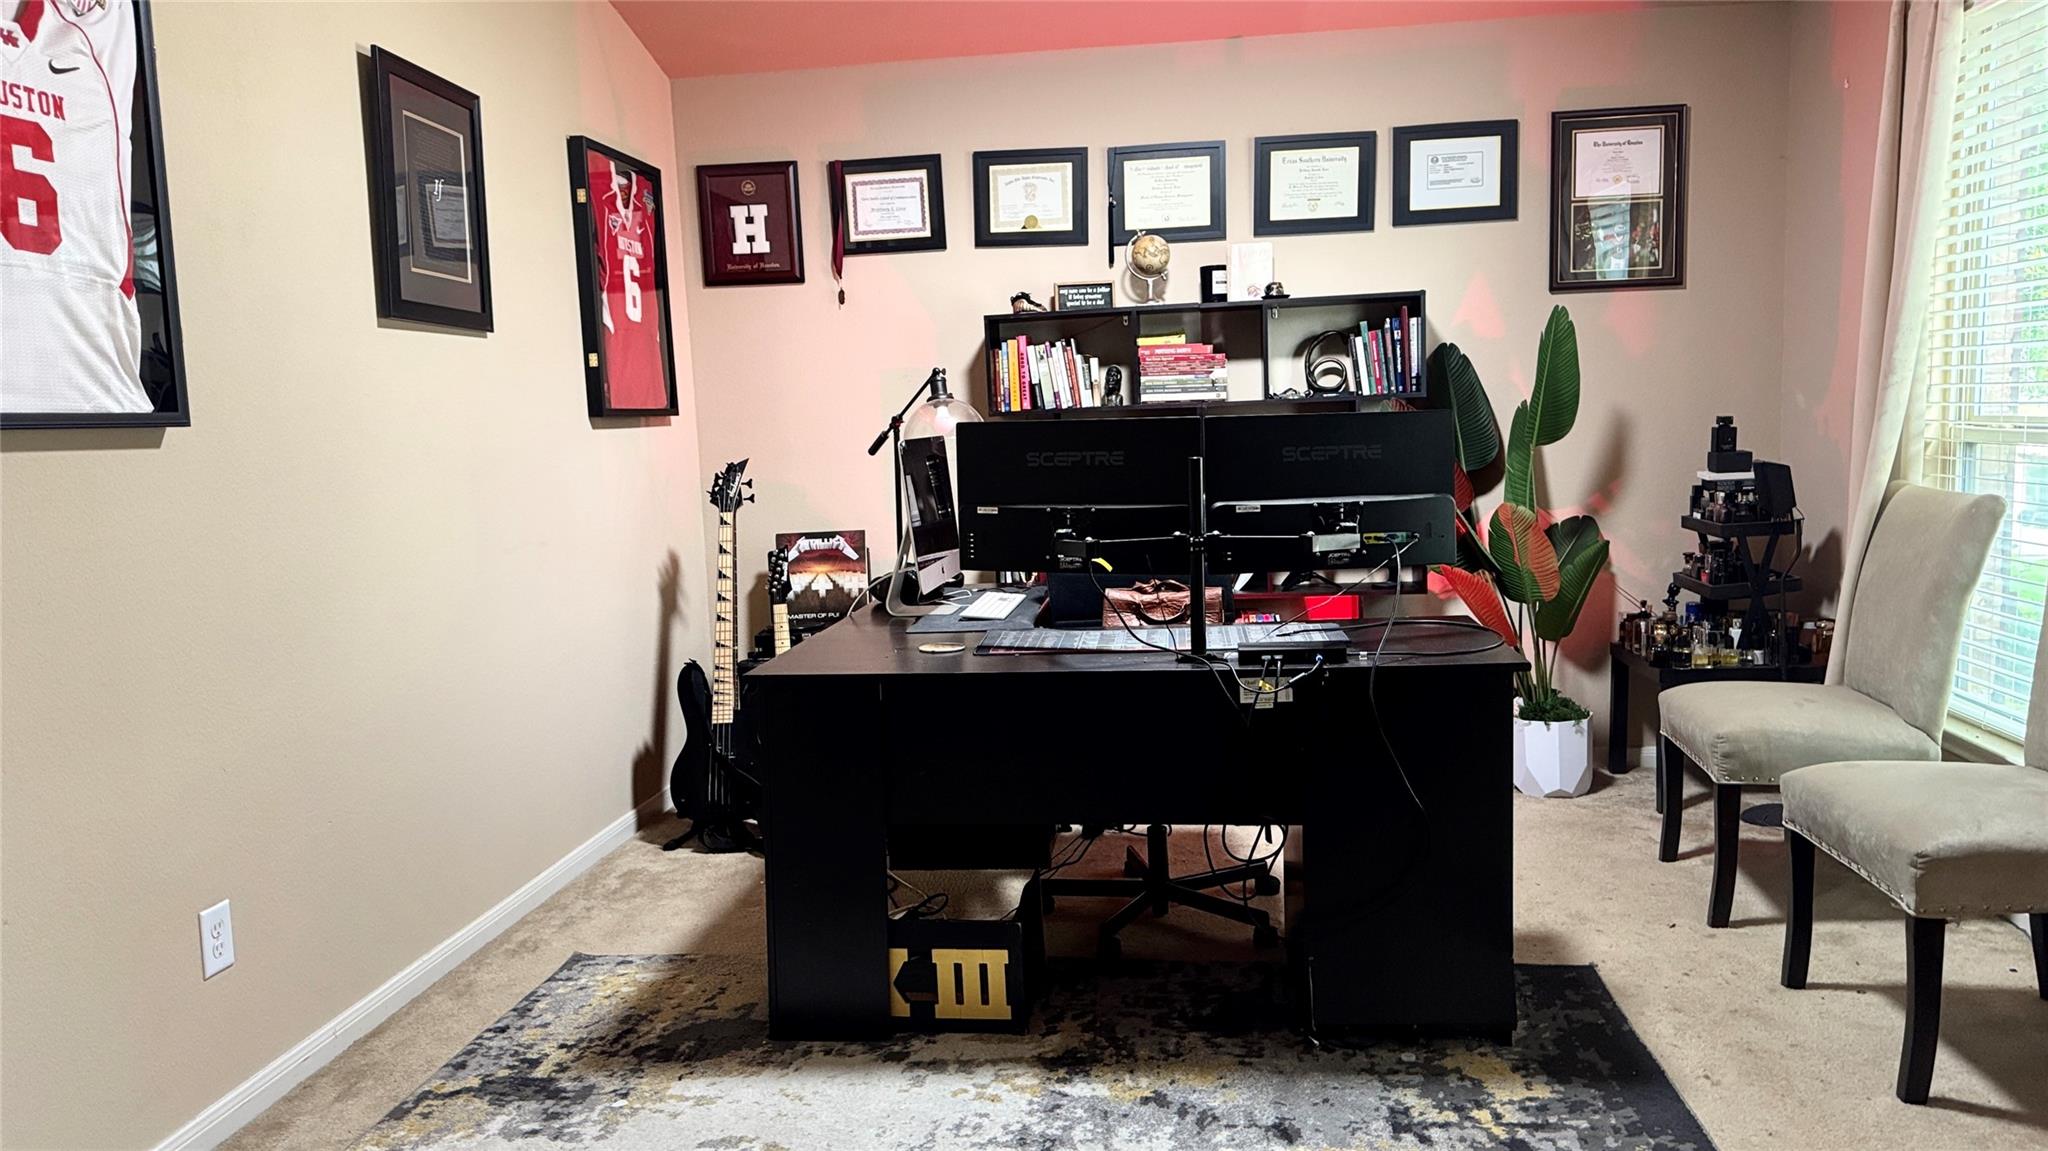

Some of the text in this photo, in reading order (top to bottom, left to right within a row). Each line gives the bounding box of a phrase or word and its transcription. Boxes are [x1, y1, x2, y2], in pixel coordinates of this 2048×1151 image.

[0, 114, 63, 256] 6
[729, 204, 771, 255] H
[623, 254, 642, 324] 6
[1026, 451, 1125, 467] SCEPTRE
[1282, 444, 1382, 461] SCEPTRE
[788, 612, 817, 620] MASTER
